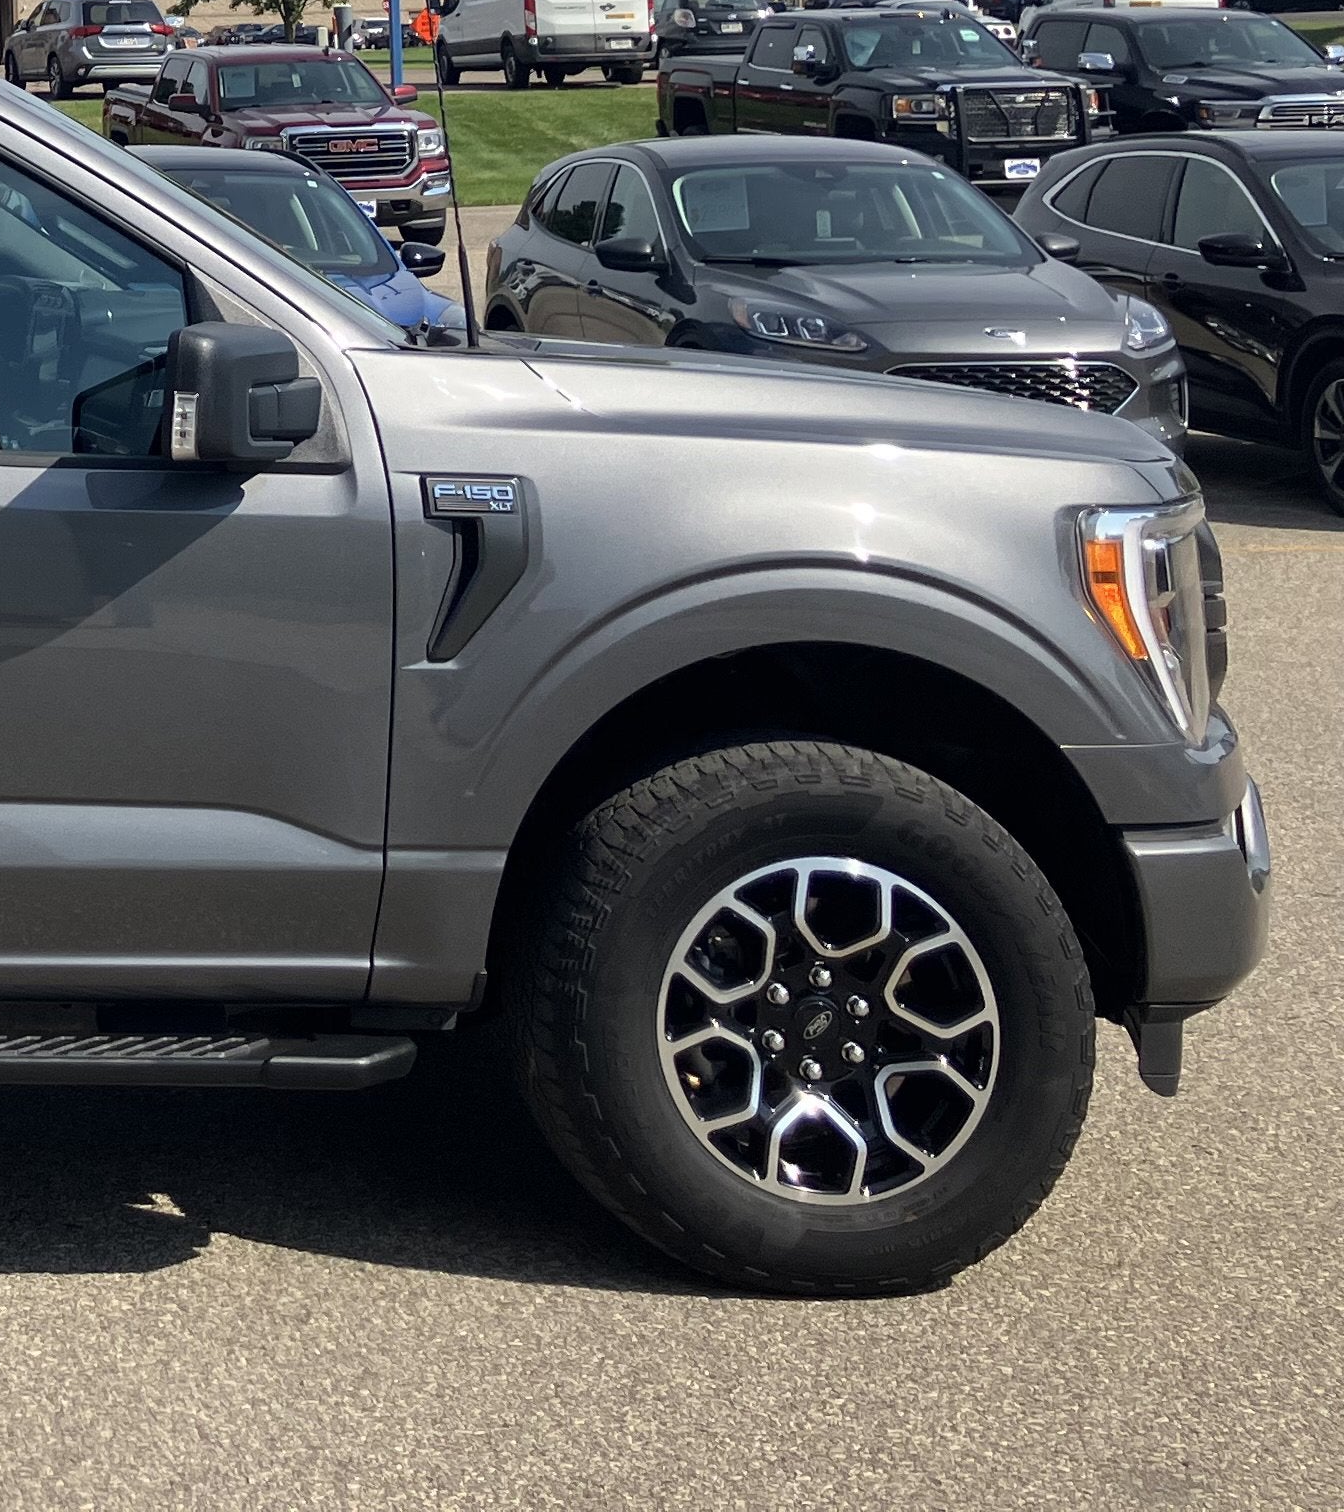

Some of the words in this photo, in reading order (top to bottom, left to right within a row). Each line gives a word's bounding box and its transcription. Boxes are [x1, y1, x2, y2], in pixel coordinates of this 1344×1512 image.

[328, 138, 379, 153] GMC
[433, 484, 514, 500] F-150
[489, 500, 512, 511] XLT
